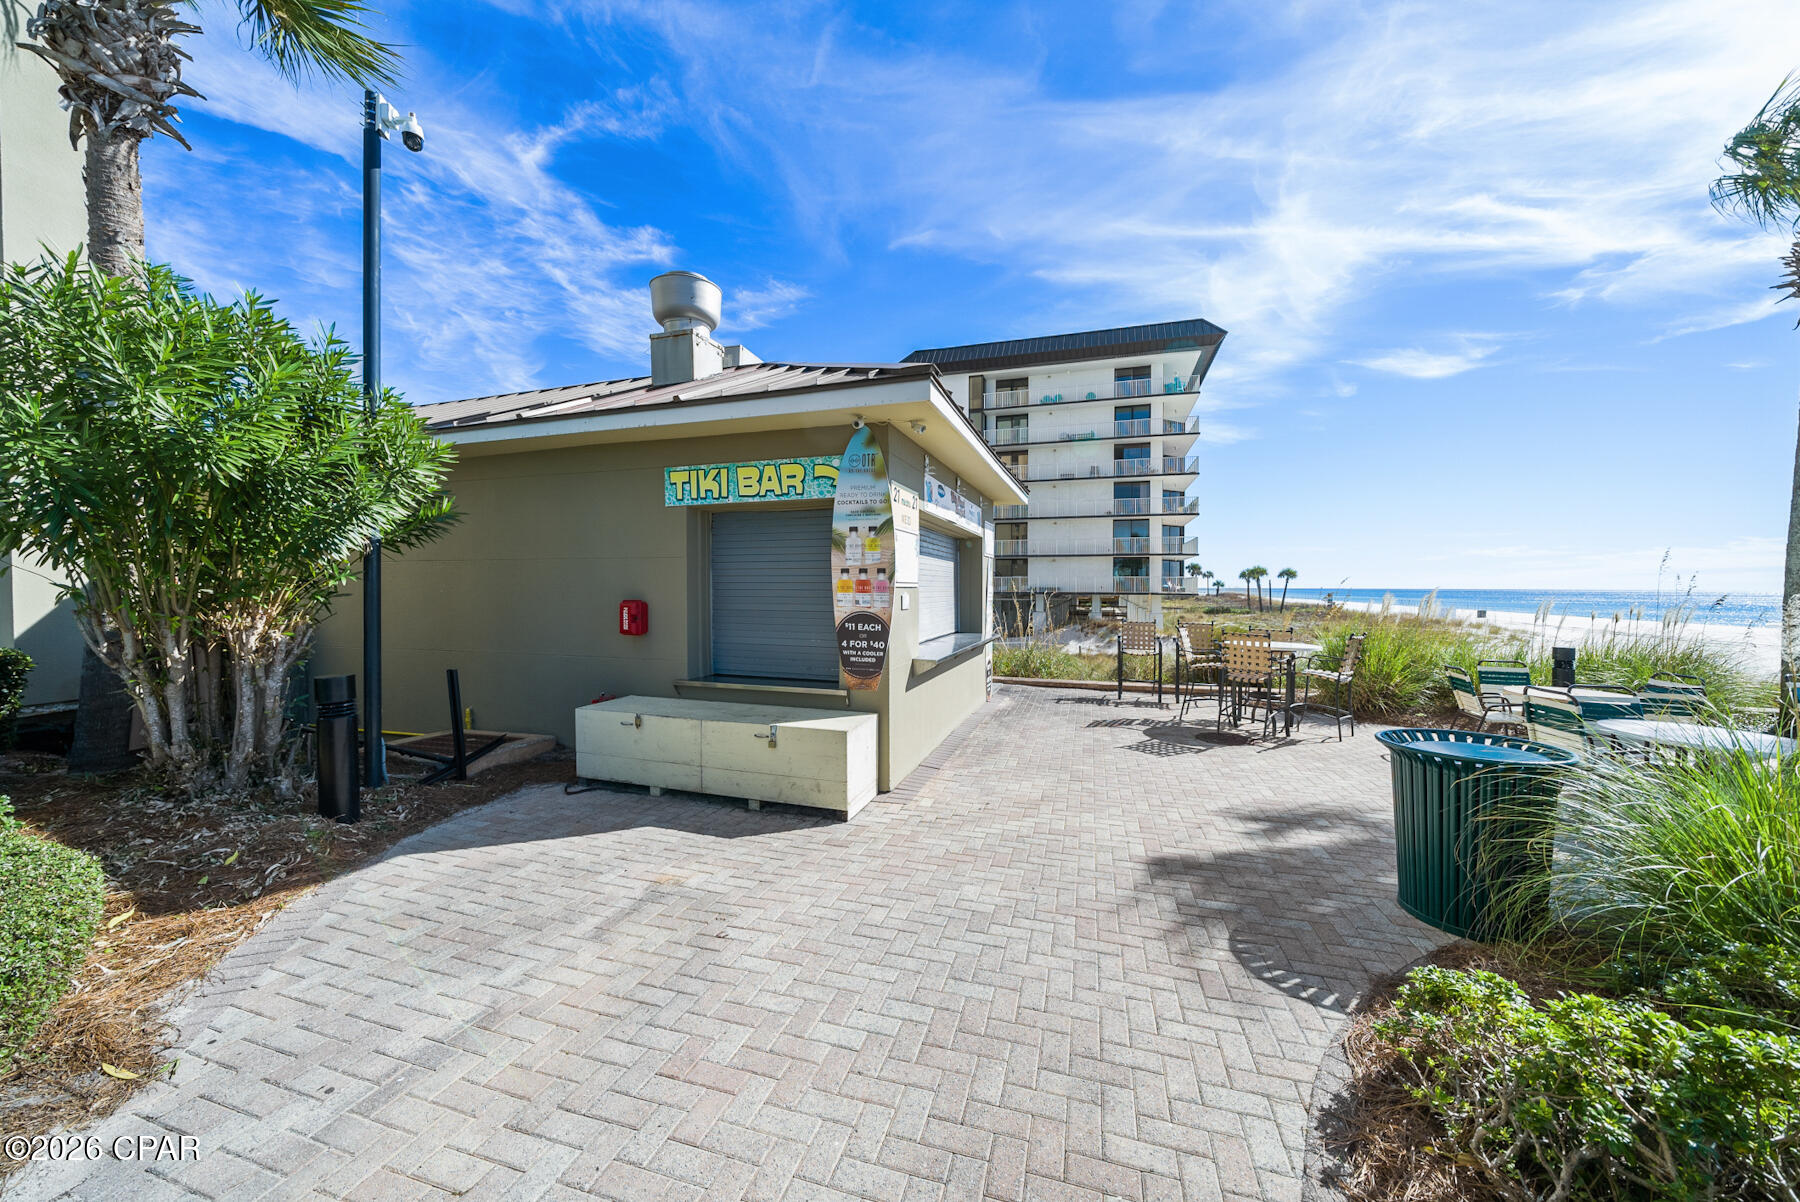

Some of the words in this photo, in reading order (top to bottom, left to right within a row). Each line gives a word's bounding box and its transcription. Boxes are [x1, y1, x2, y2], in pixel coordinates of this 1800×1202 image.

[669, 467, 729, 500] TIKI
[736, 463, 806, 497] BAR
[845, 622, 856, 631] $11
[857, 623, 882, 631] EACH
[841, 640, 848, 648] 4
[850, 640, 868, 649] FOR
[870, 640, 885, 649] $40
